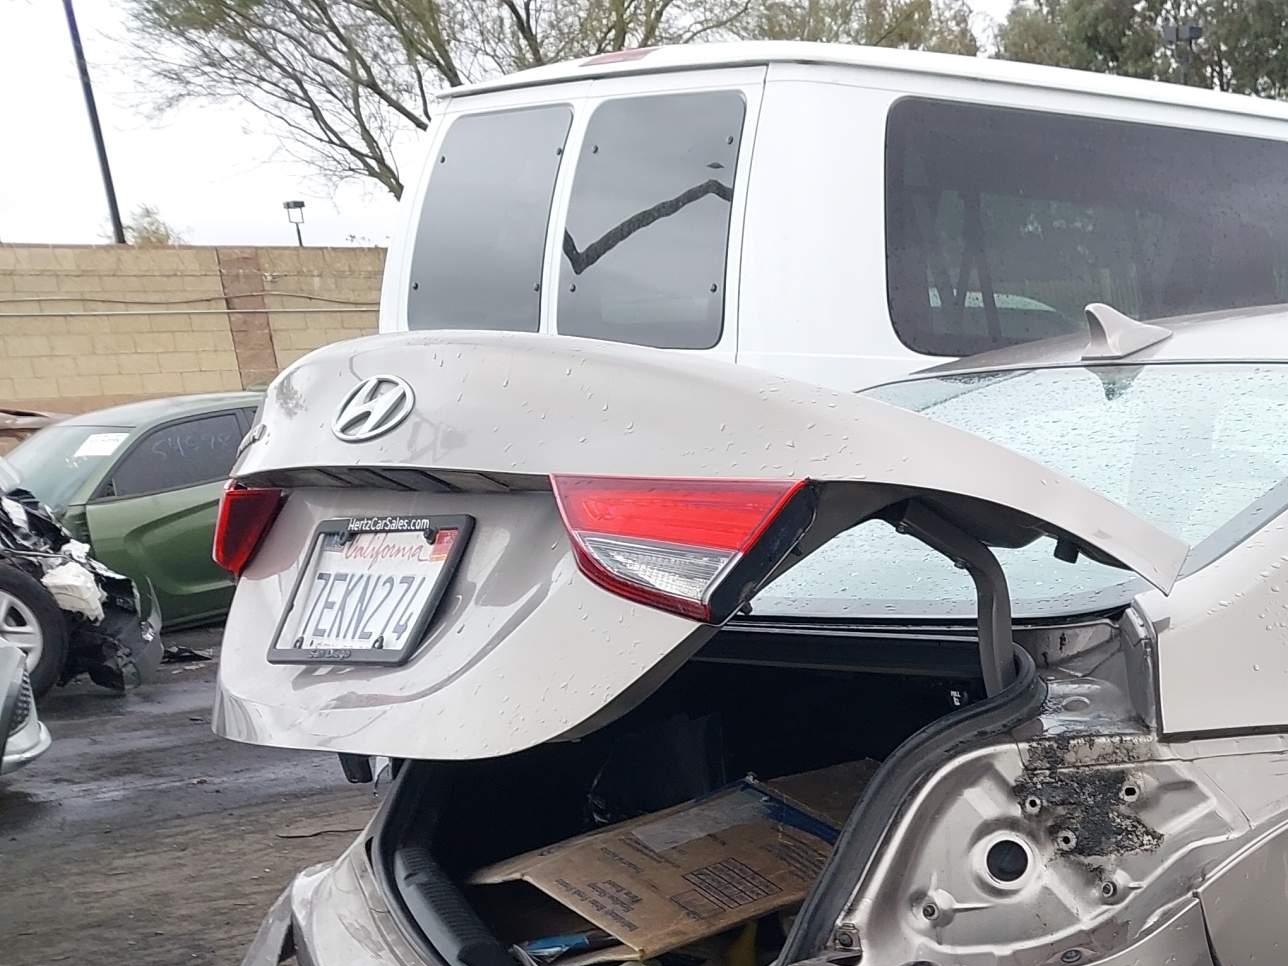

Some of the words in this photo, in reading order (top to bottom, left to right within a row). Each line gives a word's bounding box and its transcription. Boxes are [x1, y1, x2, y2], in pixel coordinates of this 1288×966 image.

[347, 517, 430, 531] HertzCarSales.com
[344, 532, 428, 570] California
[303, 573, 426, 641] 7EKN274
